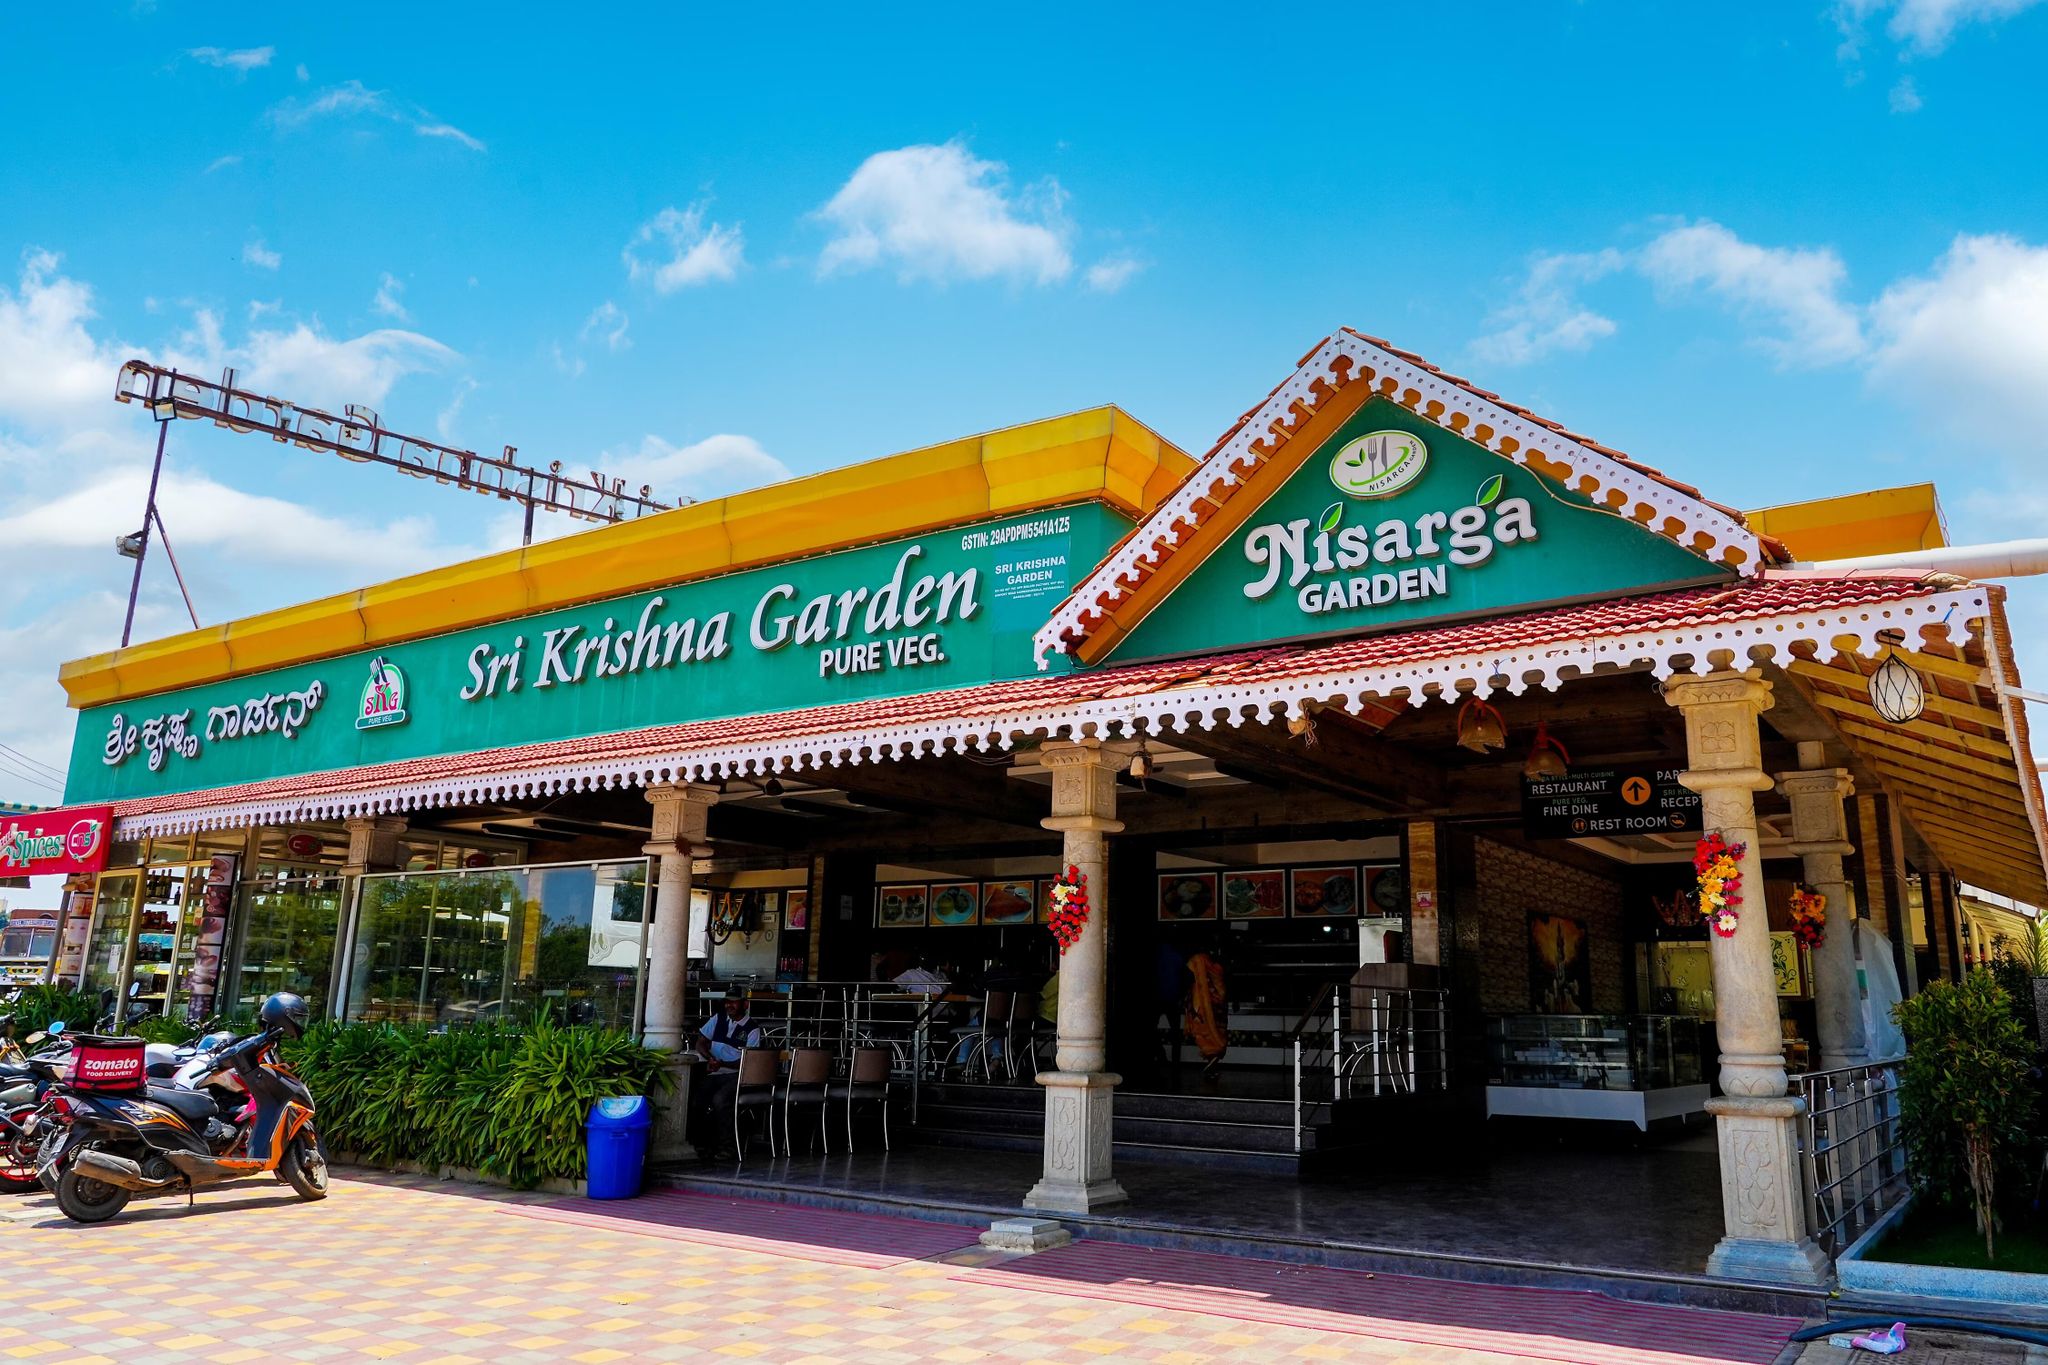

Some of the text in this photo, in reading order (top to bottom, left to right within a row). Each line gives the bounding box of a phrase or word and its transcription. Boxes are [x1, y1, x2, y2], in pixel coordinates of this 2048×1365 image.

[1369, 461, 1411, 491] NISARGA
[961, 531, 989, 551] GSTIN:
[1243, 497, 1538, 598] Nisarga
[995, 555, 1066, 575] SRI KRISHNA
[1007, 570, 1053, 585] GARDEN
[1298, 564, 1447, 614] GARDEN
[459, 544, 979, 702] Sri Krishna Garden
[818, 633, 946, 678] PURE VEG.
[368, 714, 393, 725] PURE VEG
[1531, 780, 1608, 795] RESTAURANT
[1543, 803, 1600, 817] FINE DINE
[1552, 798, 1571, 806] PURE
[1660, 795, 1702, 809] RECEP
[1590, 815, 1668, 831] REST ROOM
[13, 827, 64, 867] Spices
[84, 1058, 139, 1071] zomato
